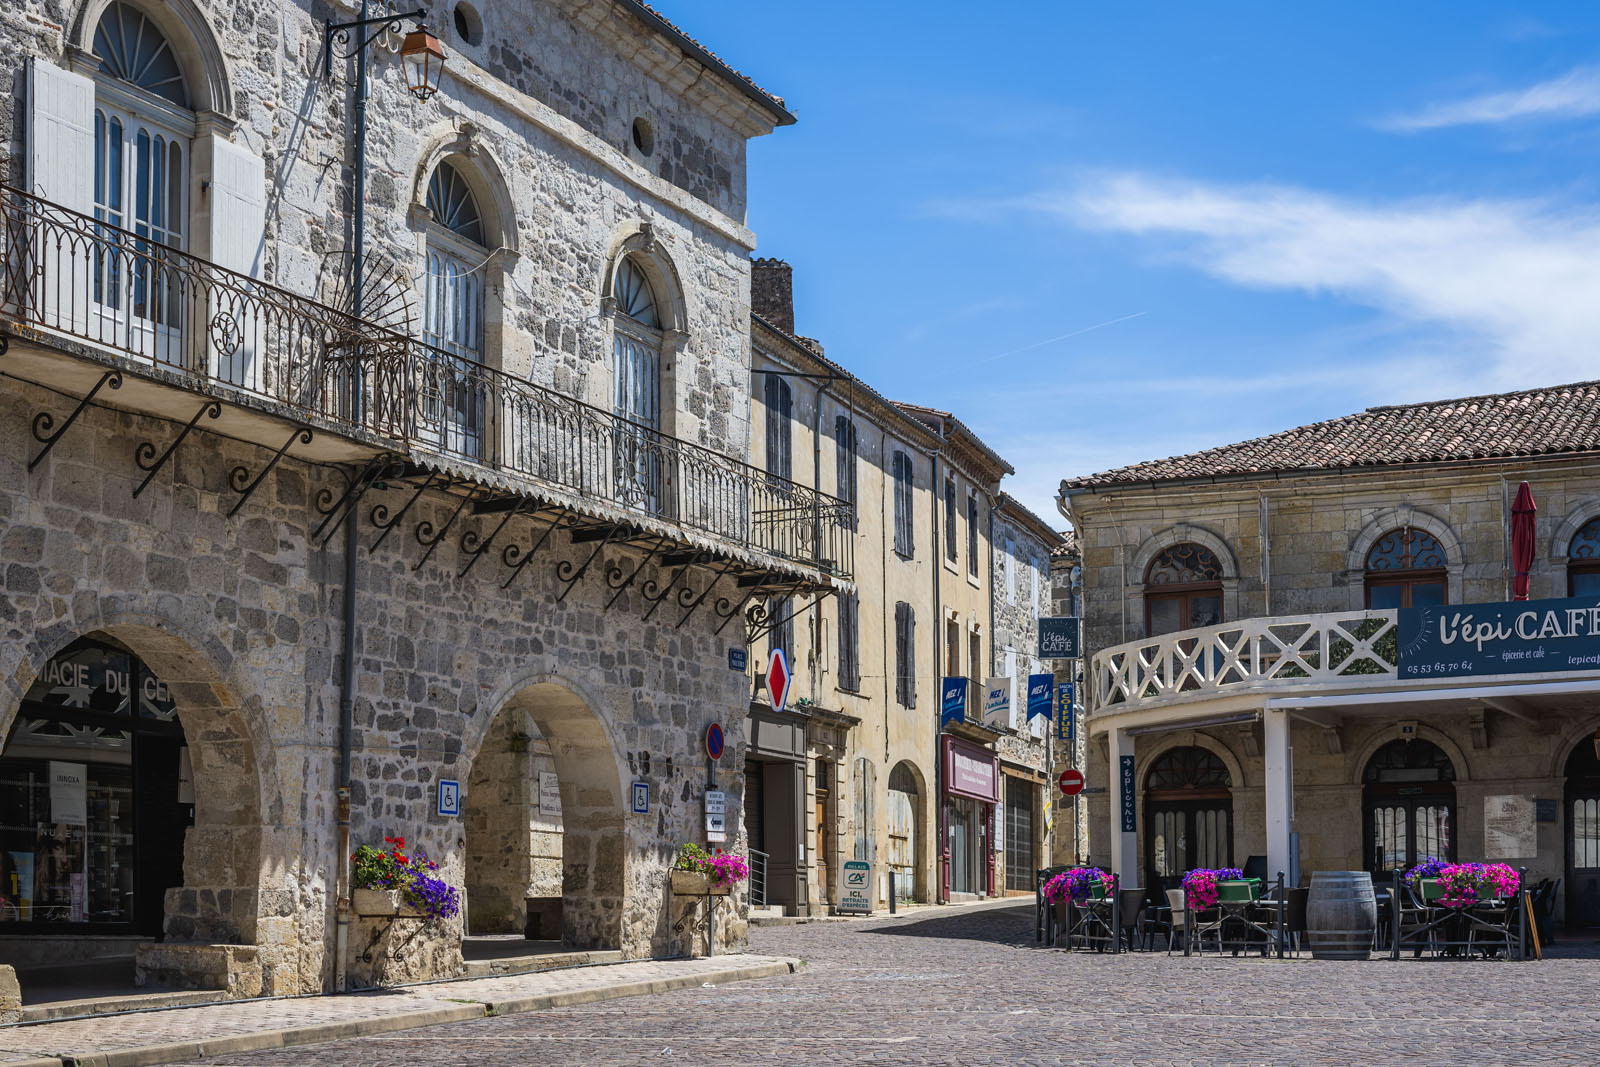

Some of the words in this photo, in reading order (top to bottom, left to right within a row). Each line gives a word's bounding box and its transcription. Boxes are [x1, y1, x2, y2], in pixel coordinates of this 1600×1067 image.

[1440, 612, 1512, 652] l'épi
[1502, 649, 1524, 662] épicerie
[1525, 650, 1531, 659] et
[1533, 646, 1544, 658] café
[1408, 666, 1418, 674] 05
[1420, 664, 1431, 673] 53
[1434, 662, 1445, 672] 65
[1448, 663, 1458, 672] 70
[1461, 660, 1472, 670] 64
[105, 669, 129, 696] DU
[1060, 693, 1071, 737] COIFFURE
[57, 775, 80, 784] INNOXA
